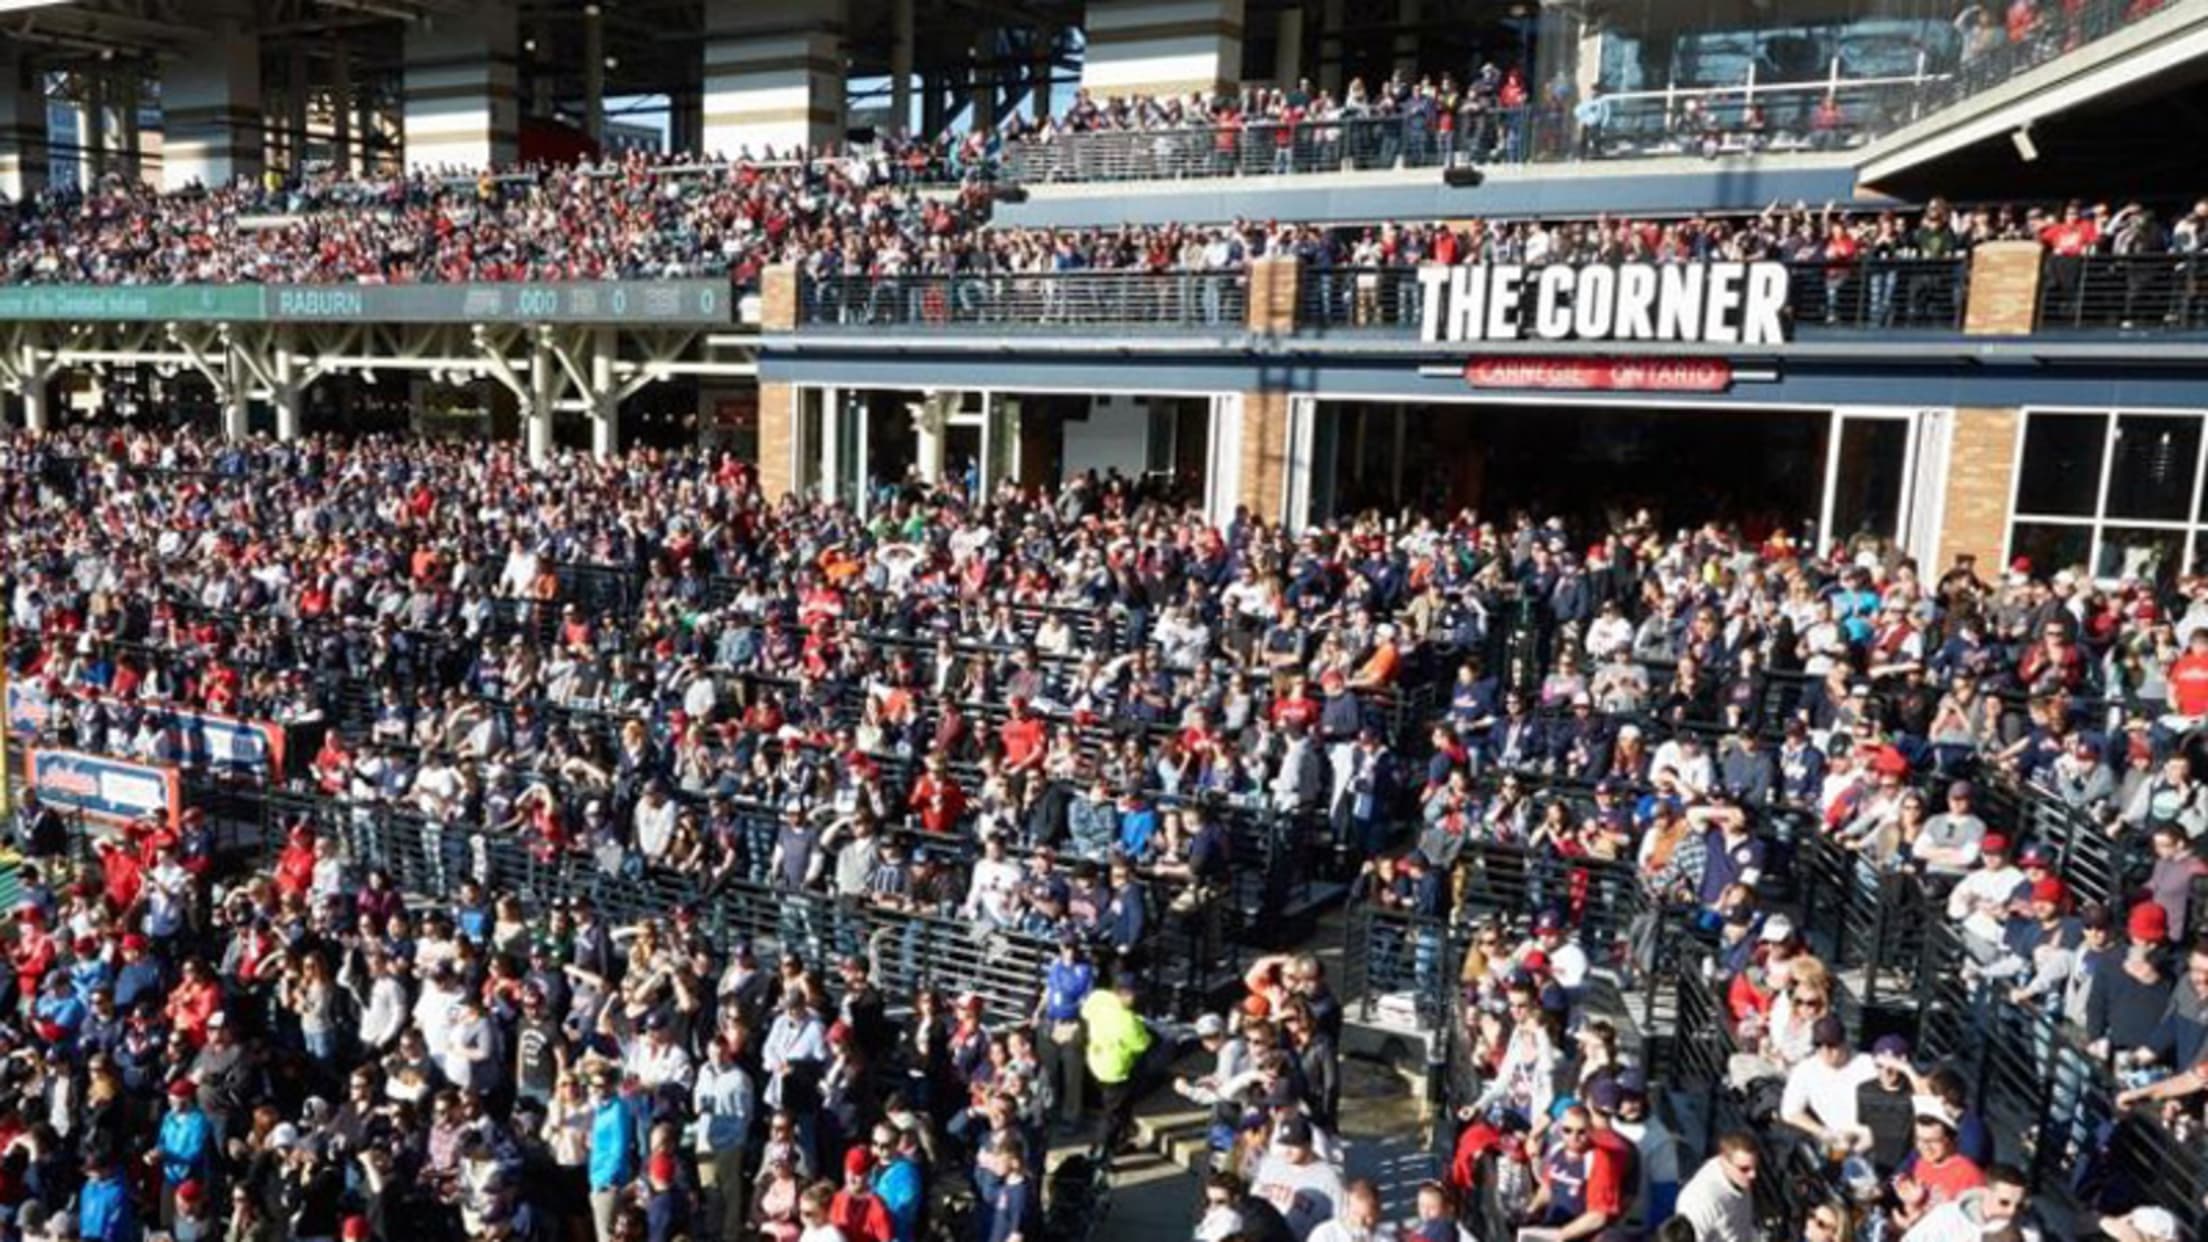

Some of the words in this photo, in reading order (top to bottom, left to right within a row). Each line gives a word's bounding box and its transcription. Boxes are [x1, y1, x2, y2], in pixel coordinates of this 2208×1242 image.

[280, 291, 363, 315] RABURN
[515, 289, 558, 315] .000
[613, 289, 626, 315] 0
[701, 289, 714, 315] 0
[1418, 262, 1523, 343] THE
[1537, 262, 1789, 344] CORNER
[1481, 361, 1583, 382] CARNEGIE
[1611, 362, 1717, 385] ONTARIO
